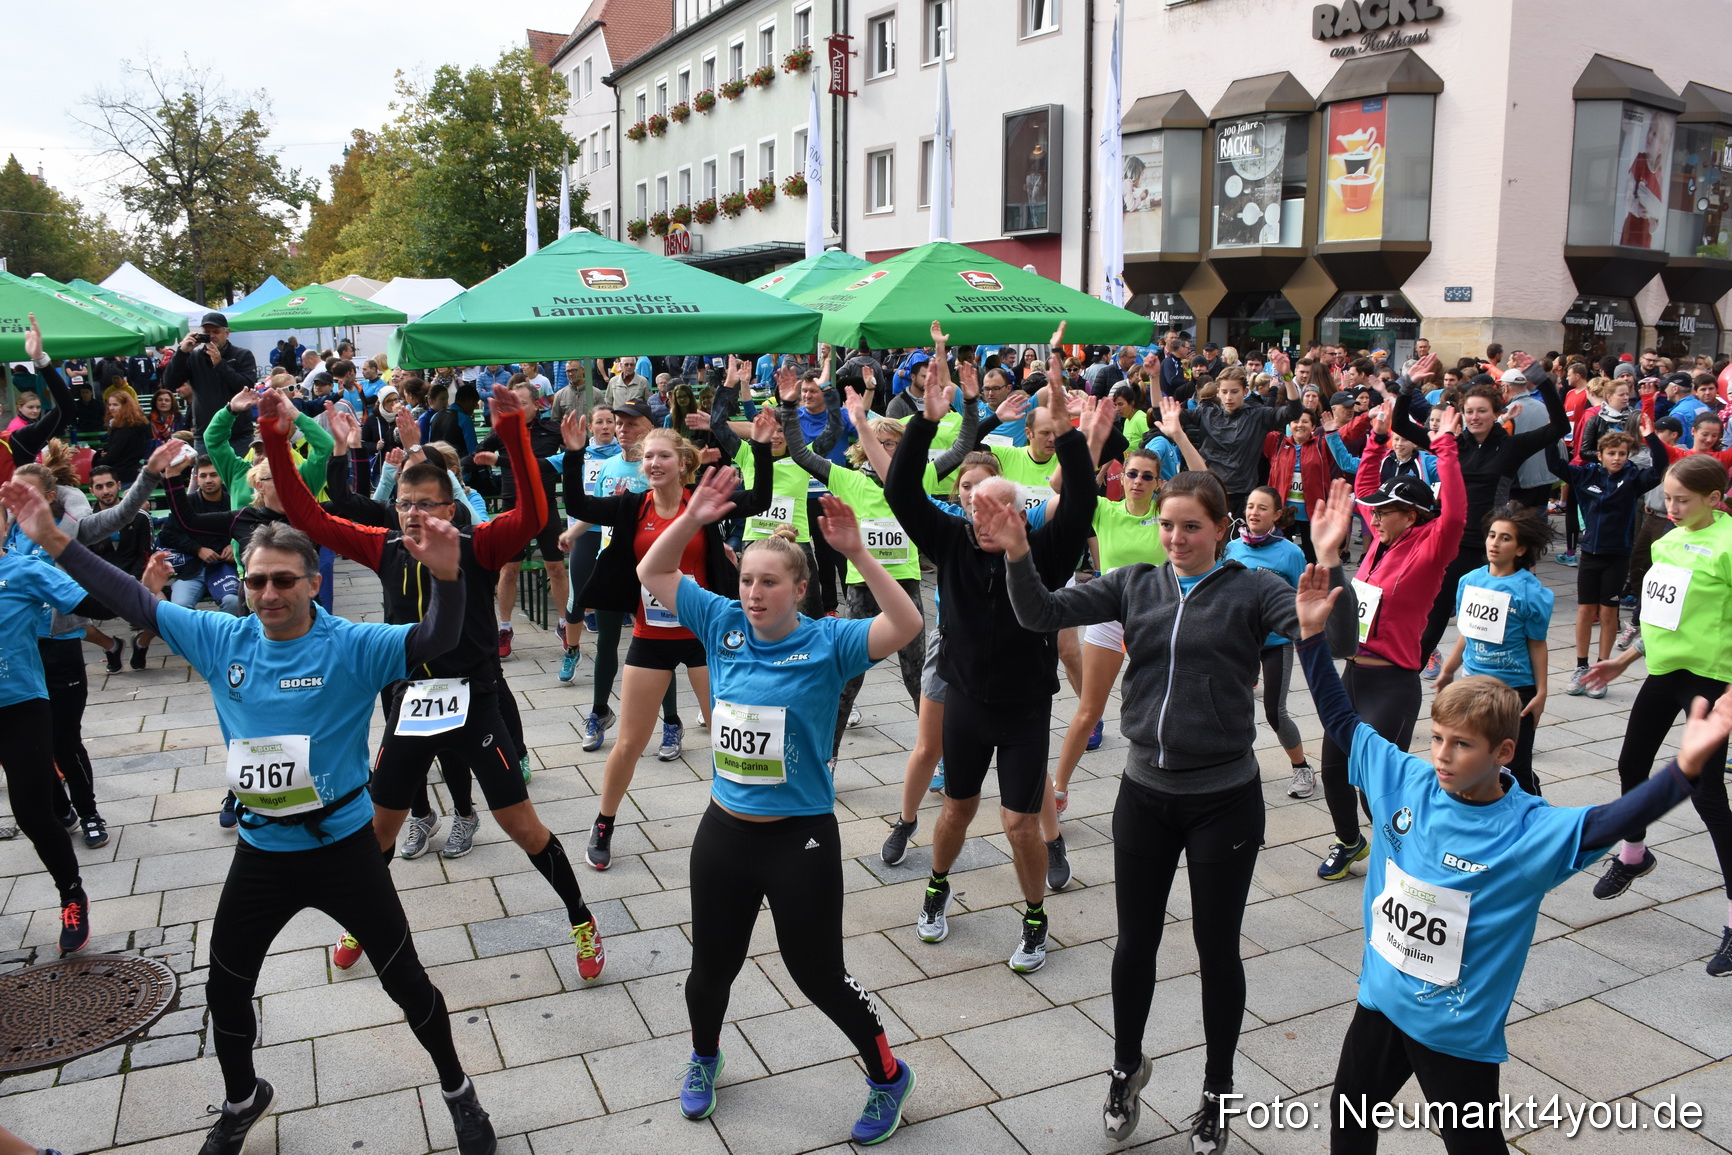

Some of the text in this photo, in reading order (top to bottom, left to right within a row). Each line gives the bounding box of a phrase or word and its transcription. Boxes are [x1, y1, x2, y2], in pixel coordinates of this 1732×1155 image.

[1312, 0, 1443, 40] RACKL
[1330, 28, 1430, 58] am Rathaus
[832, 47, 845, 92] Achatz
[1223, 121, 1259, 137] 100 Jahre
[1220, 135, 1253, 158] RACKL
[663, 230, 690, 256] RENO
[552, 294, 672, 305] Neumarkter
[944, 303, 1069, 314] Lammsbräu
[954, 295, 1042, 304] Neumarkter
[532, 302, 700, 318] Lammsbräu
[1359, 313, 1385, 327] RACKL
[868, 532, 903, 546] 5106
[1466, 602, 1499, 622] 4028
[280, 676, 324, 690] BOCK
[411, 696, 459, 717] 2714
[720, 720, 771, 755] 5037
[724, 757, 769, 771] Anna-Carina
[239, 762, 296, 789] 5167
[259, 795, 287, 806] Holger
[1382, 896, 1447, 946] 4026
[1386, 932, 1434, 964] Maximilian
